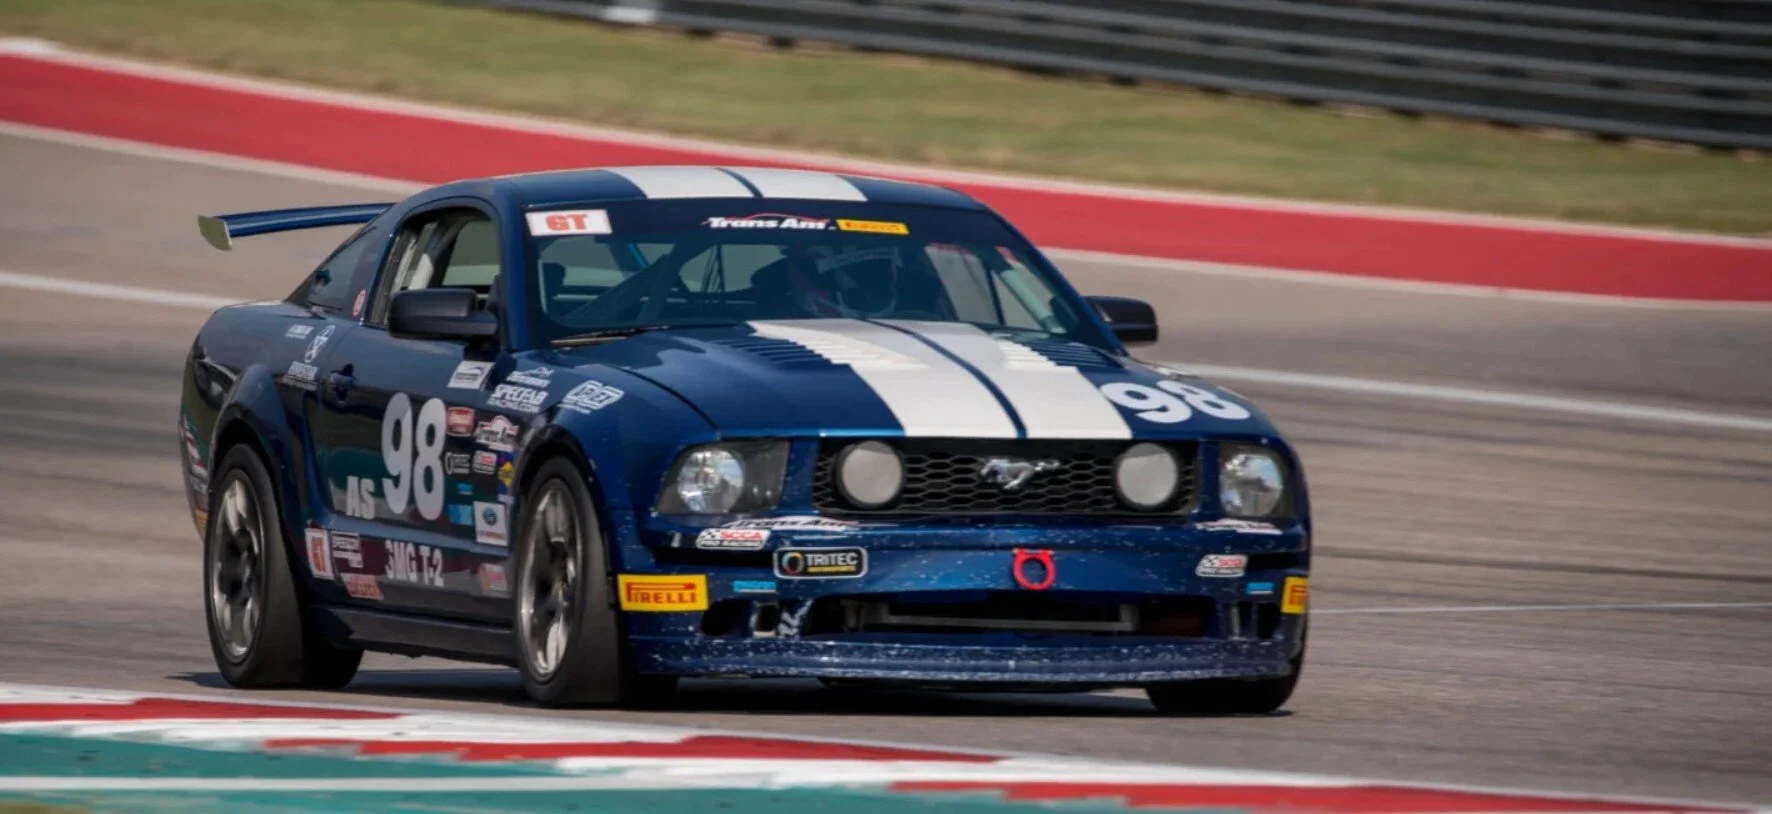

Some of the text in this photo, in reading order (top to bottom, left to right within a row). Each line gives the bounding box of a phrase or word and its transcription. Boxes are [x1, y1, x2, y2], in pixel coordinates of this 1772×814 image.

[545, 213, 588, 231] GT
[708, 216, 826, 230] Trans Am
[491, 383, 549, 406] SPECFAB
[1099, 379, 1252, 424] 98
[381, 392, 447, 521] 98
[346, 475, 376, 520] AS
[720, 530, 762, 541] SCCA
[419, 545, 445, 588] T-2
[805, 552, 859, 566] TRITEC
[626, 582, 697, 604] PIRELLI
